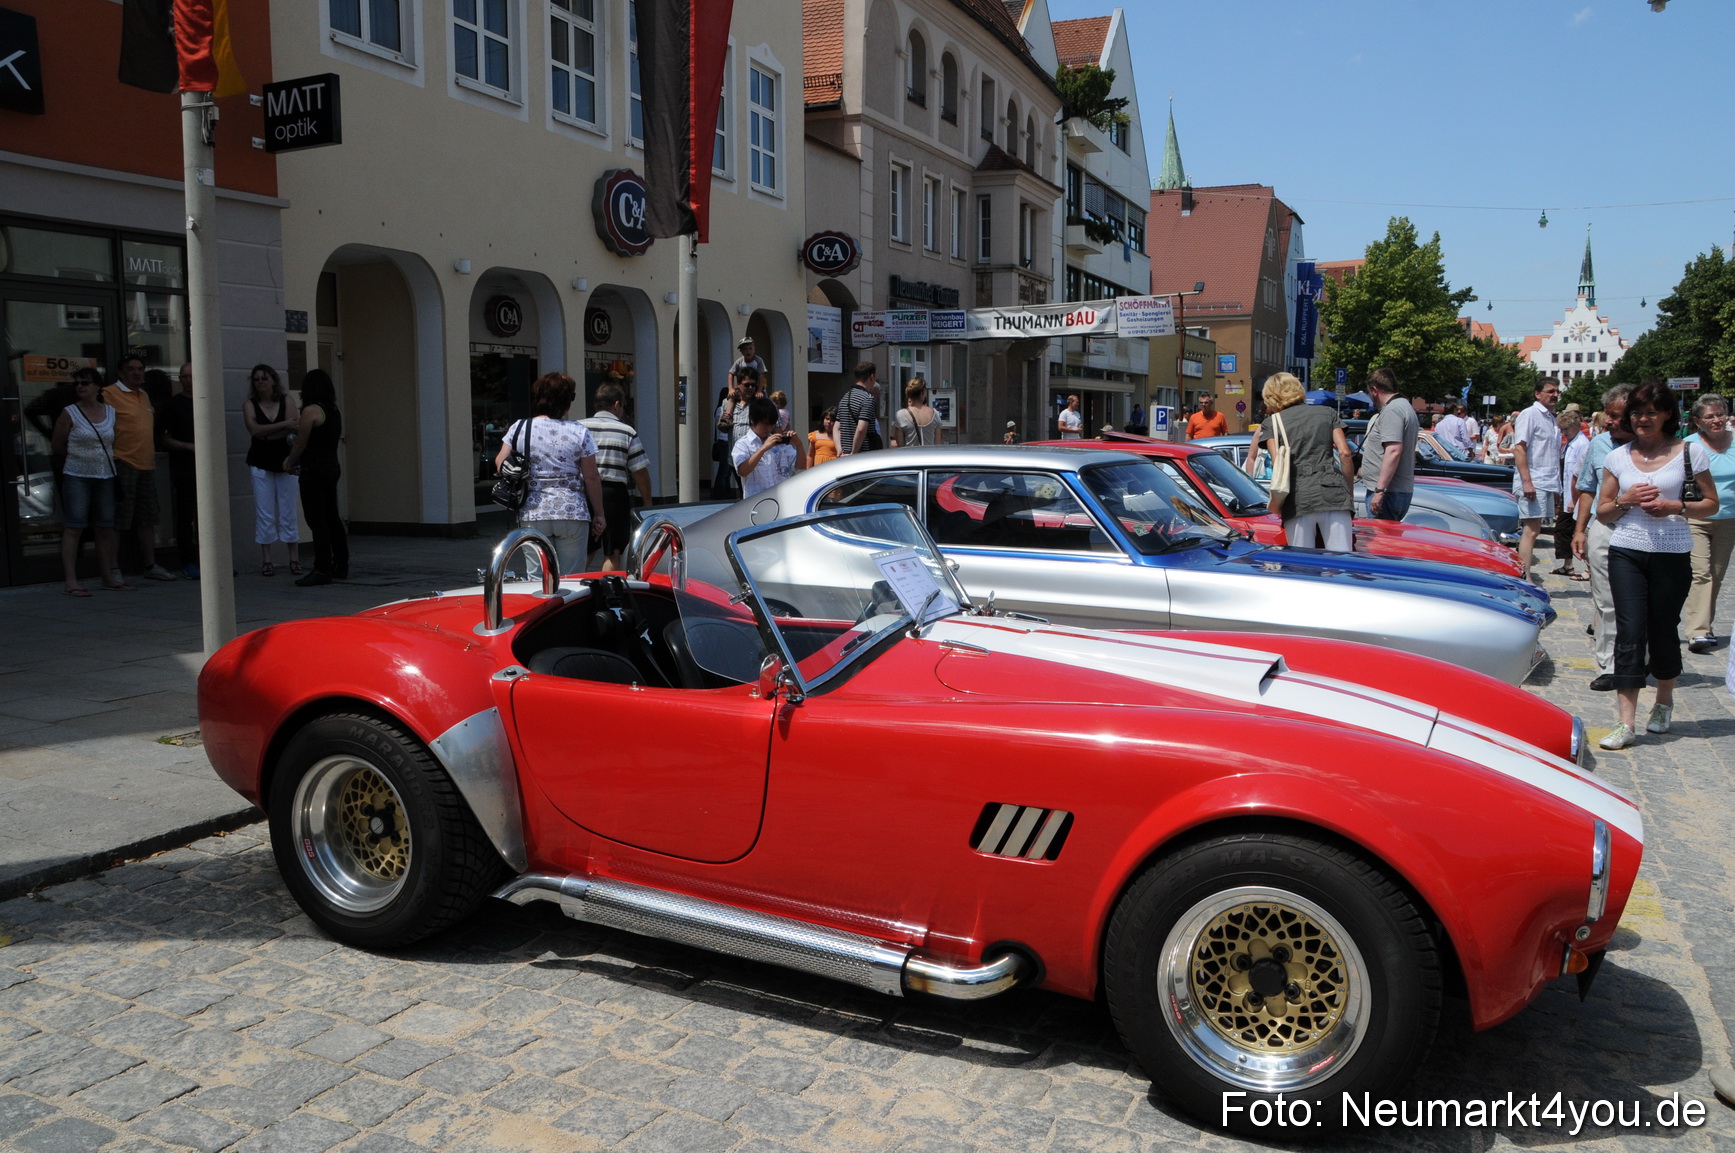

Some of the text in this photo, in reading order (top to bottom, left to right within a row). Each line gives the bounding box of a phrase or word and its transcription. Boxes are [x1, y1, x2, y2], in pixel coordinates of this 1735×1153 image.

[267, 83, 325, 117] MATT
[275, 117, 318, 143] optik
[812, 243, 845, 262] C&A
[130, 257, 163, 273] MATT
[500, 307, 518, 325] C&A
[594, 318, 609, 334] C&A
[1338, 370, 1344, 382] P
[1158, 411, 1165, 422] P
